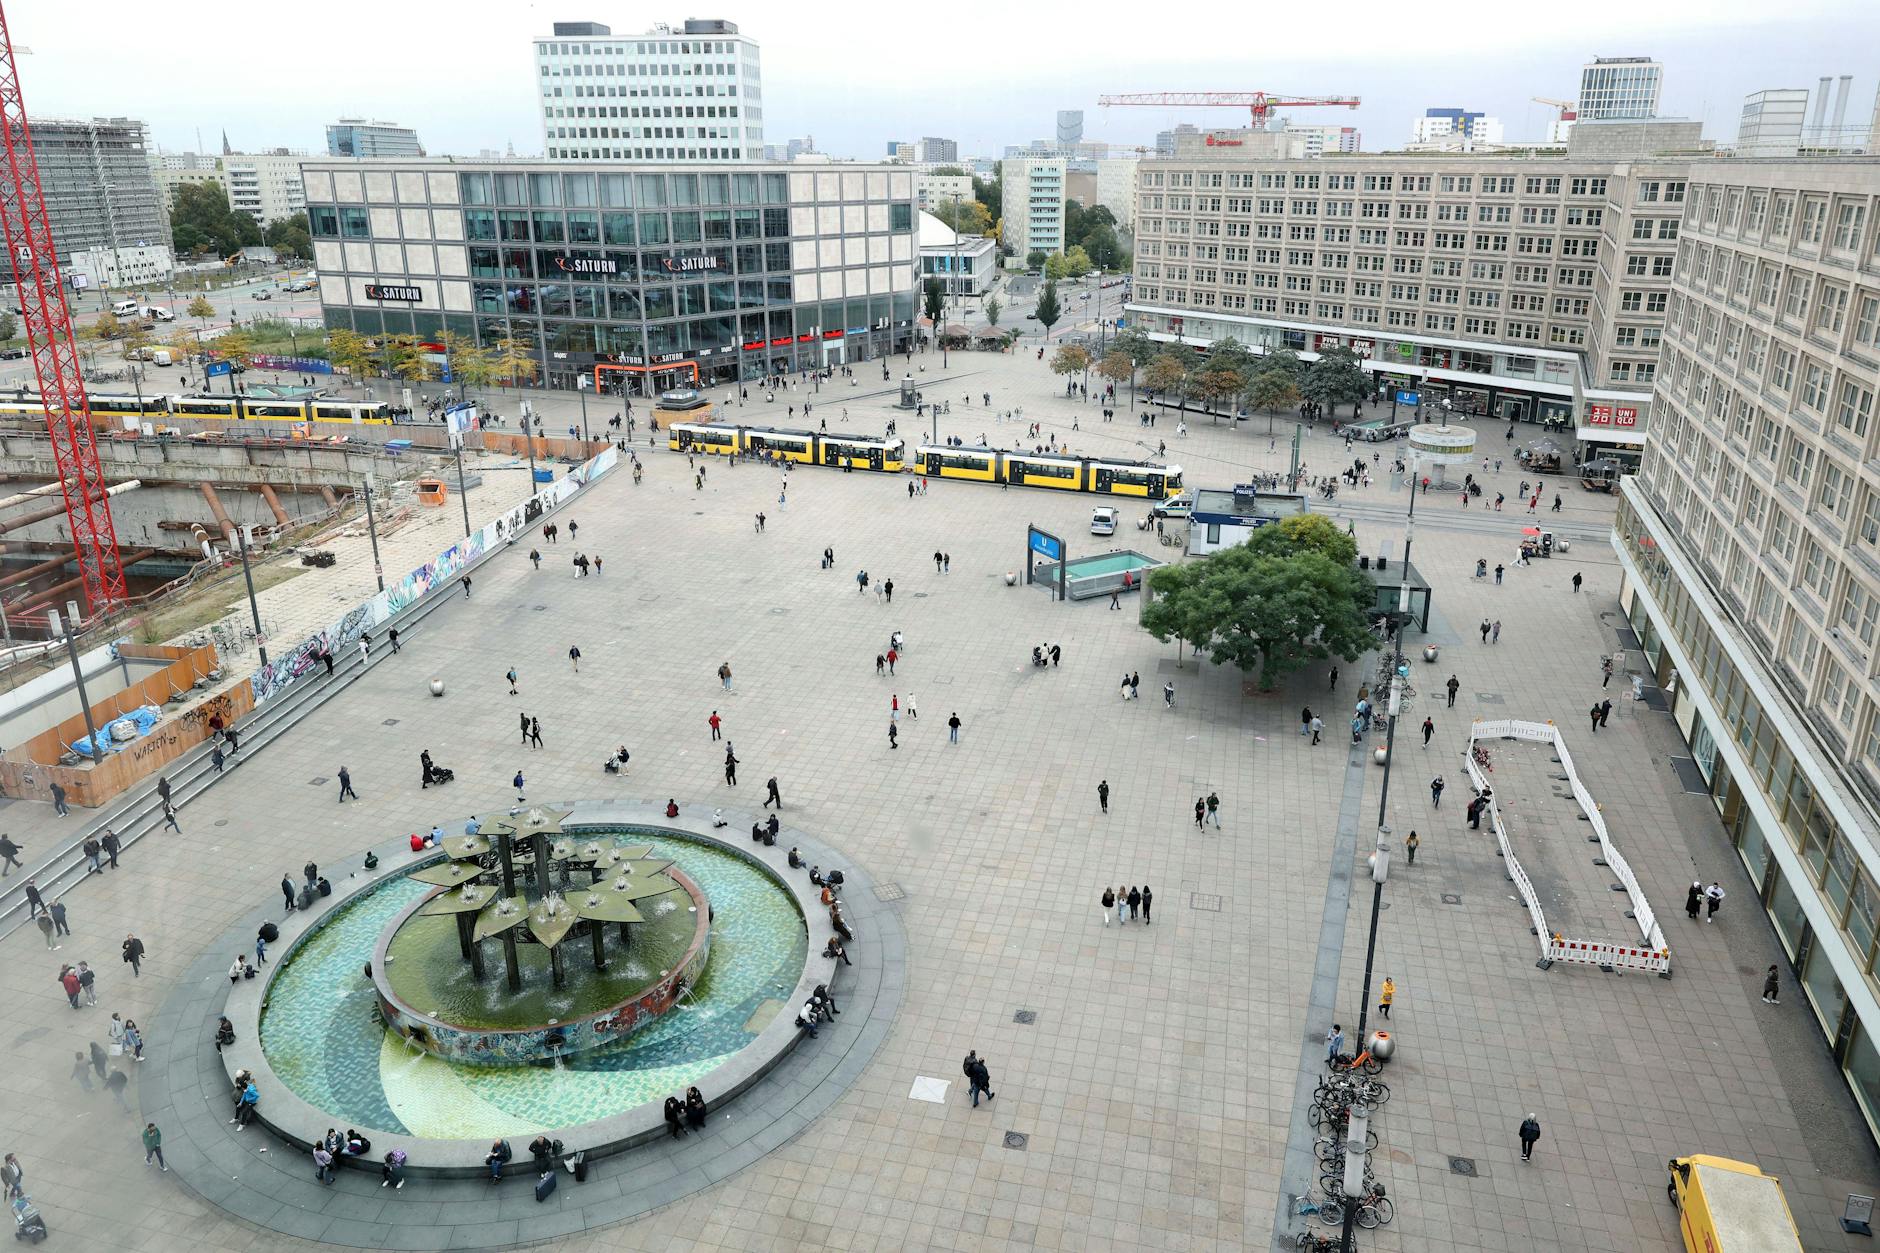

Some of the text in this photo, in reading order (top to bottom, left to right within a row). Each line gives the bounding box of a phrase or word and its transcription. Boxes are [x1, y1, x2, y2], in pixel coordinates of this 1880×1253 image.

[22, 248, 30, 259] 4
[575, 259, 616, 273] SATURN
[681, 256, 717, 270] SATURN
[383, 287, 420, 300] SATURN
[1322, 337, 1339, 345] FIVE
[1353, 340, 1370, 348] FIVE
[618, 355, 643, 364] SATURN
[662, 352, 684, 363] SATURN
[1618, 409, 1633, 417] UNI
[1041, 537, 1047, 547] U
